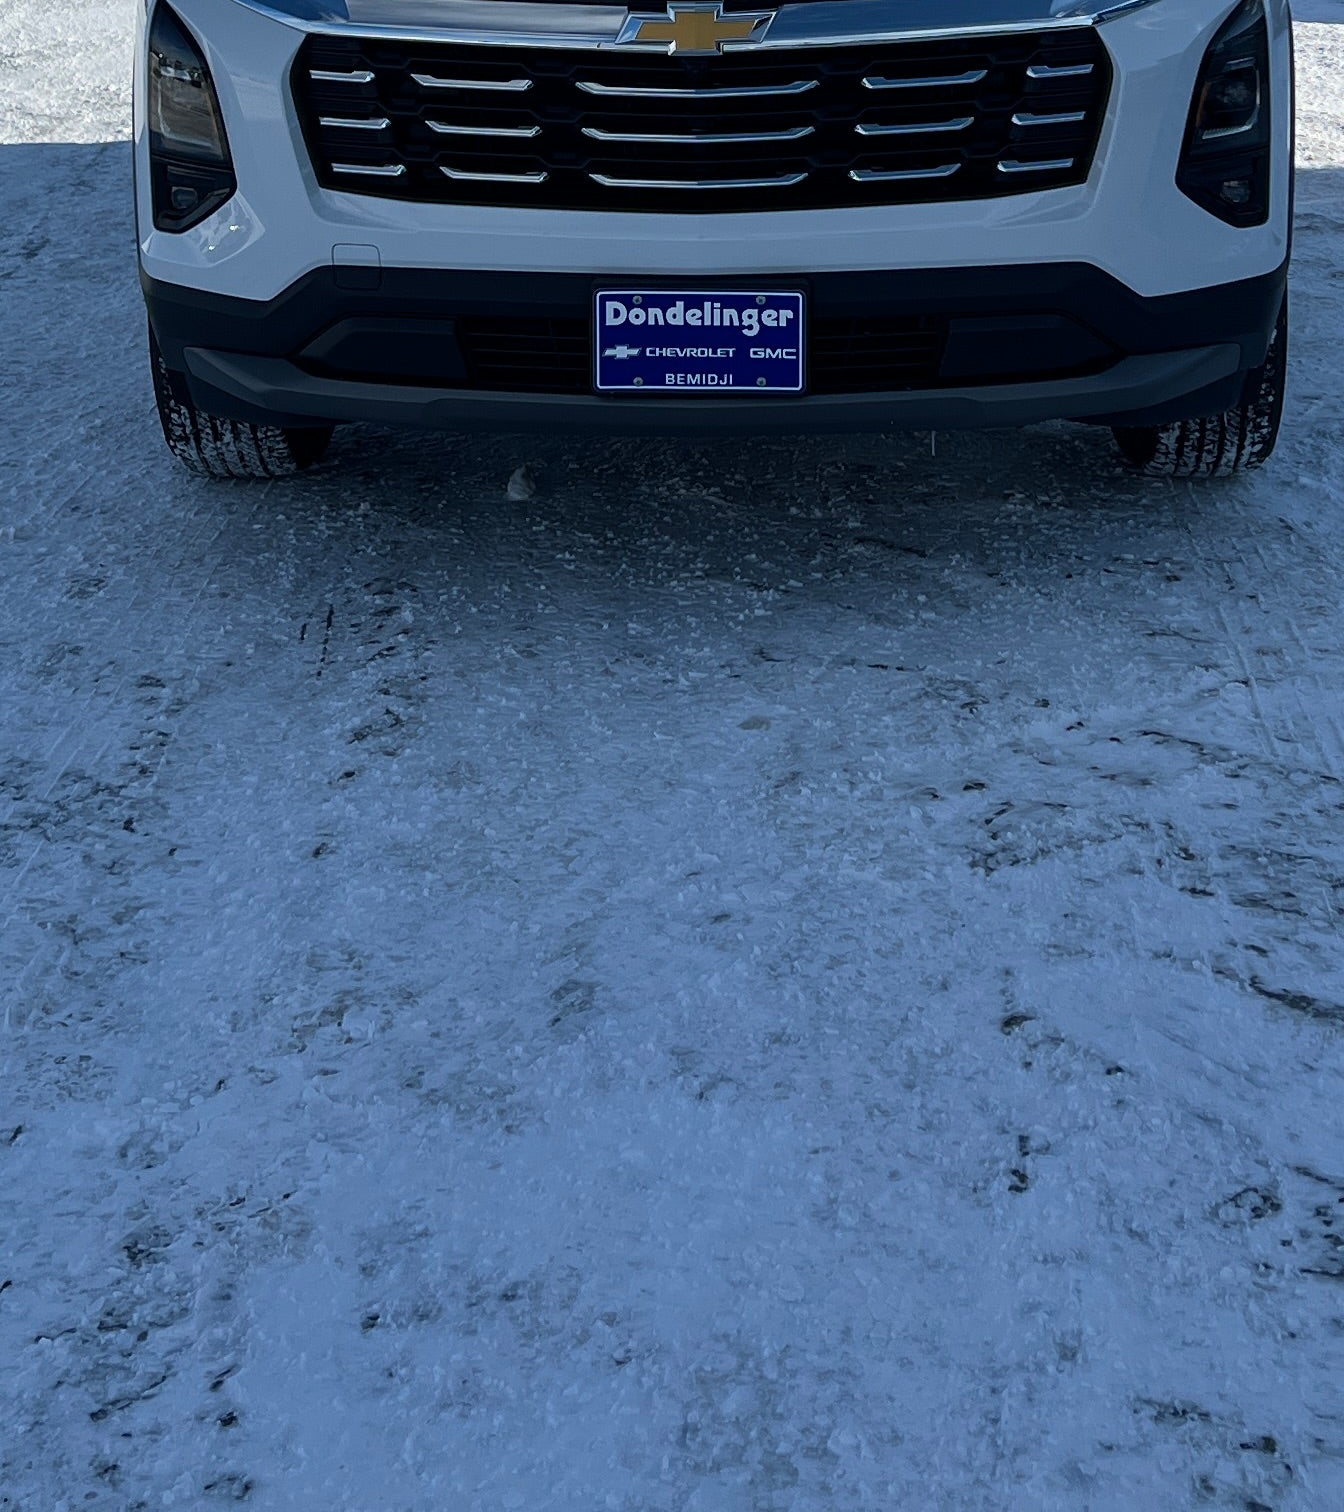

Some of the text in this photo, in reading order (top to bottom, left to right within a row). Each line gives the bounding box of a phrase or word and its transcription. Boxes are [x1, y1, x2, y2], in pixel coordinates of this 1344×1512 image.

[605, 301, 794, 336] Dondelinger
[645, 347, 797, 359] CHEVROLET GMC
[665, 373, 733, 385] BEMIDJI
